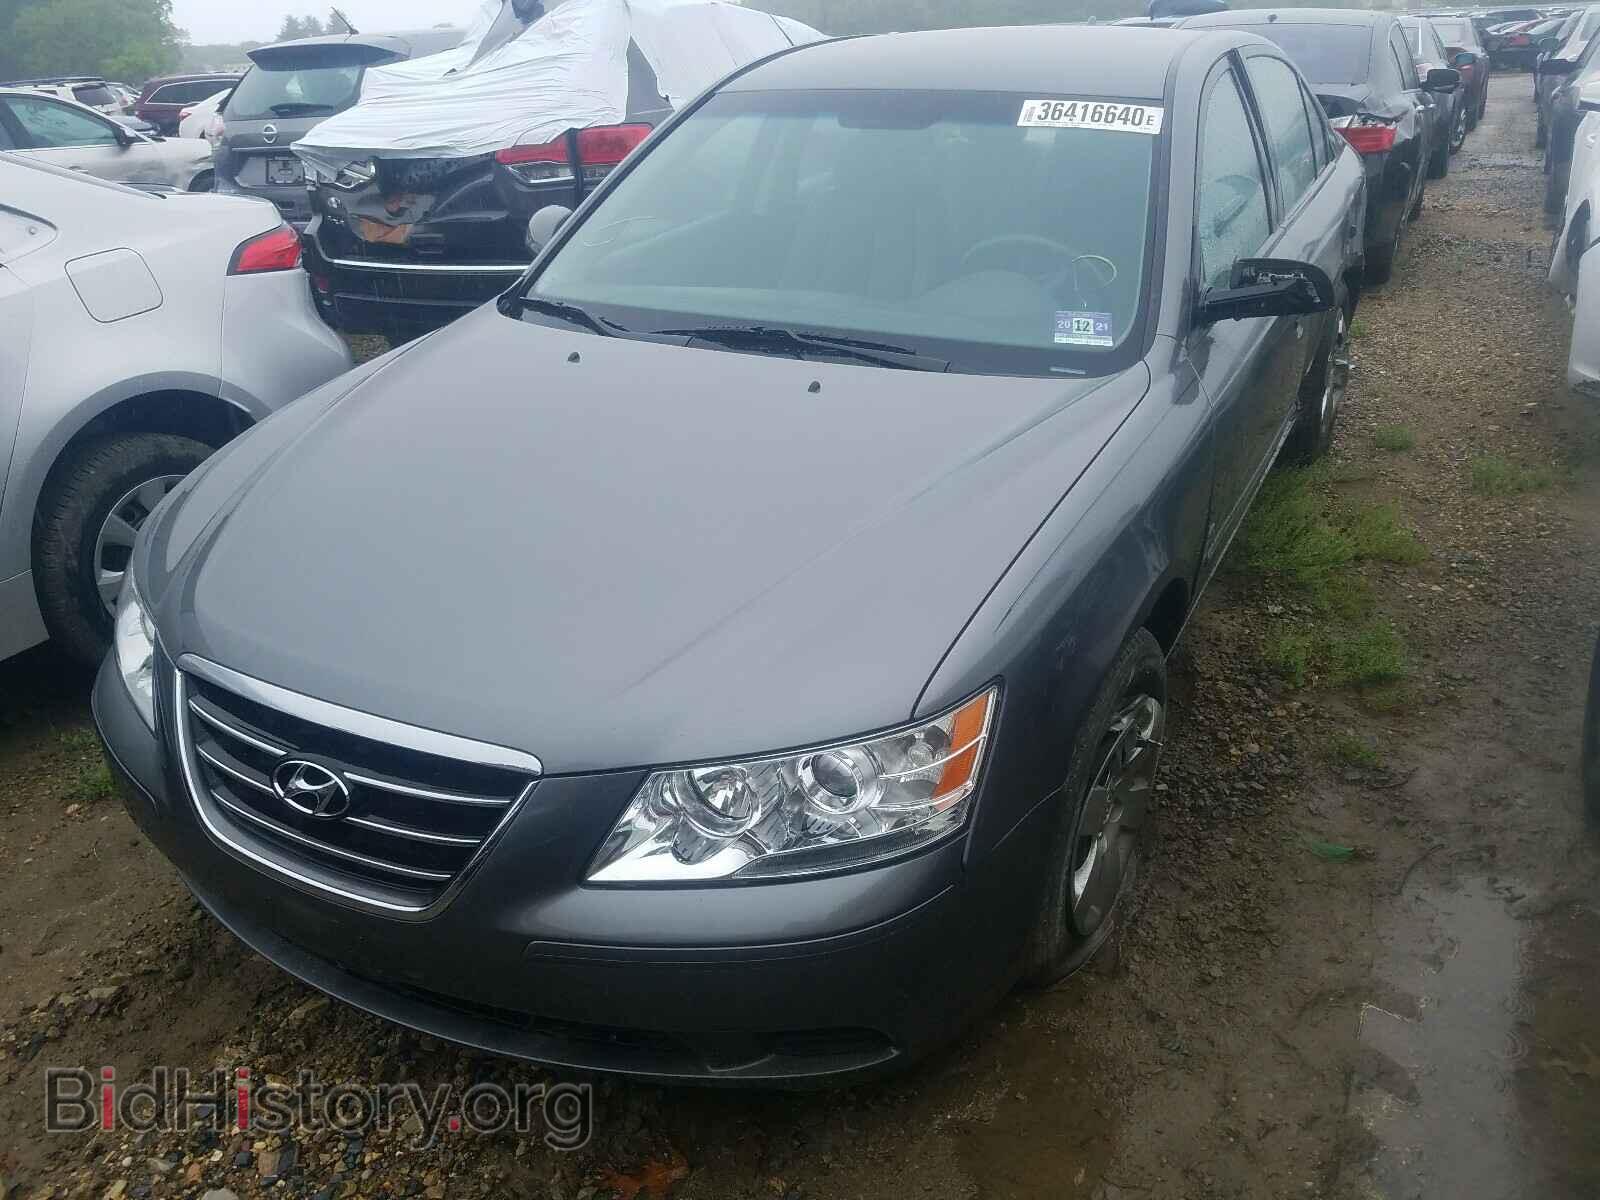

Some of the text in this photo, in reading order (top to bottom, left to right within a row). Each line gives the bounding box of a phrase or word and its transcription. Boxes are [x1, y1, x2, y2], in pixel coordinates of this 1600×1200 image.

[1037, 102, 1144, 127] 36416640
[1146, 115, 1155, 126] E
[1074, 319, 1090, 332] 12
